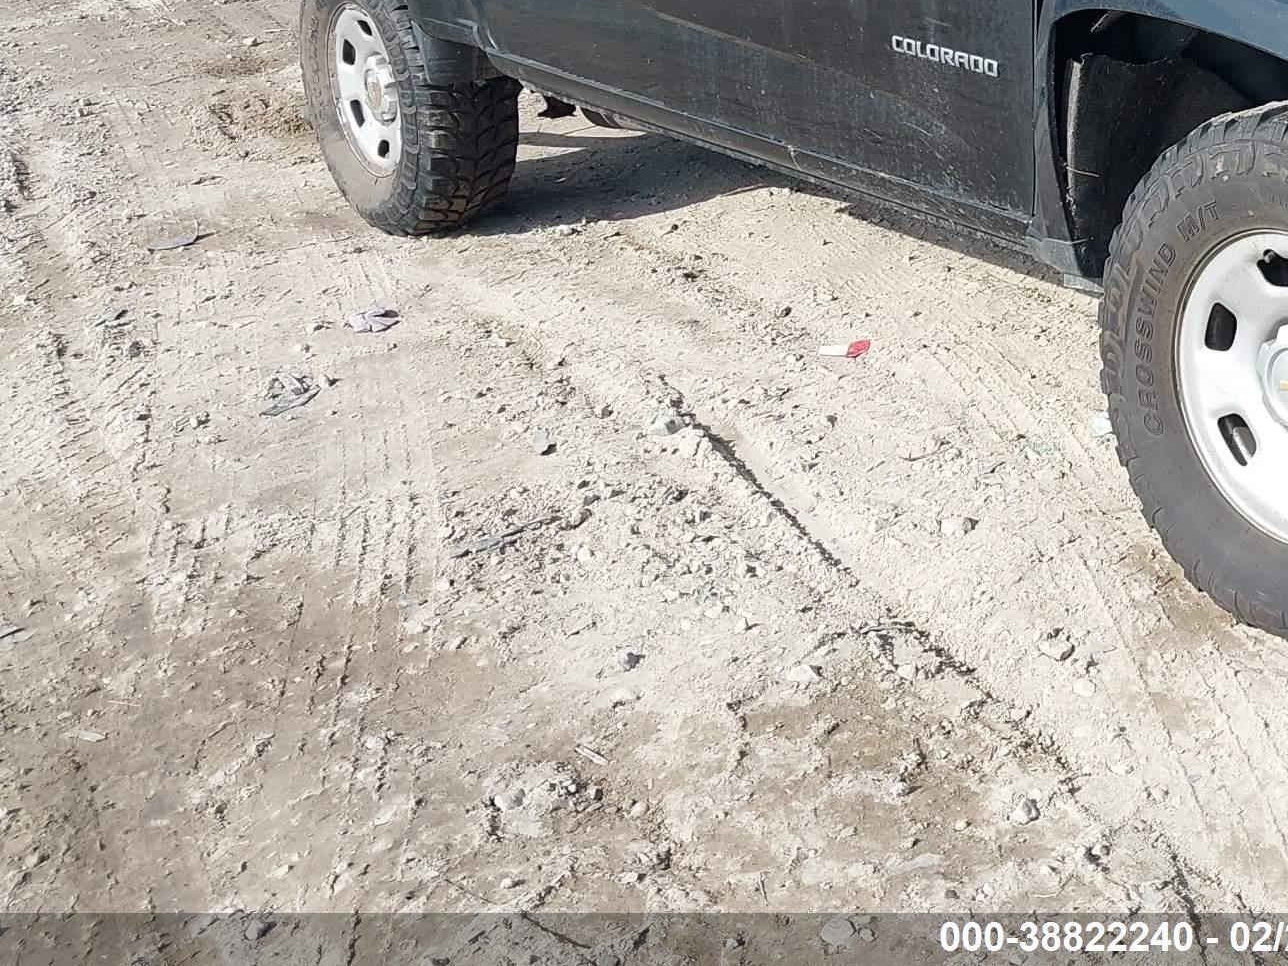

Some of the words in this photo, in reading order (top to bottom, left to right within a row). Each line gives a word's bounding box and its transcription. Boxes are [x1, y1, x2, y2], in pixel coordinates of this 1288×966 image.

[891, 35, 999, 78] COLORADO
[1134, 242, 1177, 436] CROSSWIND
[1176, 200, 1220, 243] M/T
